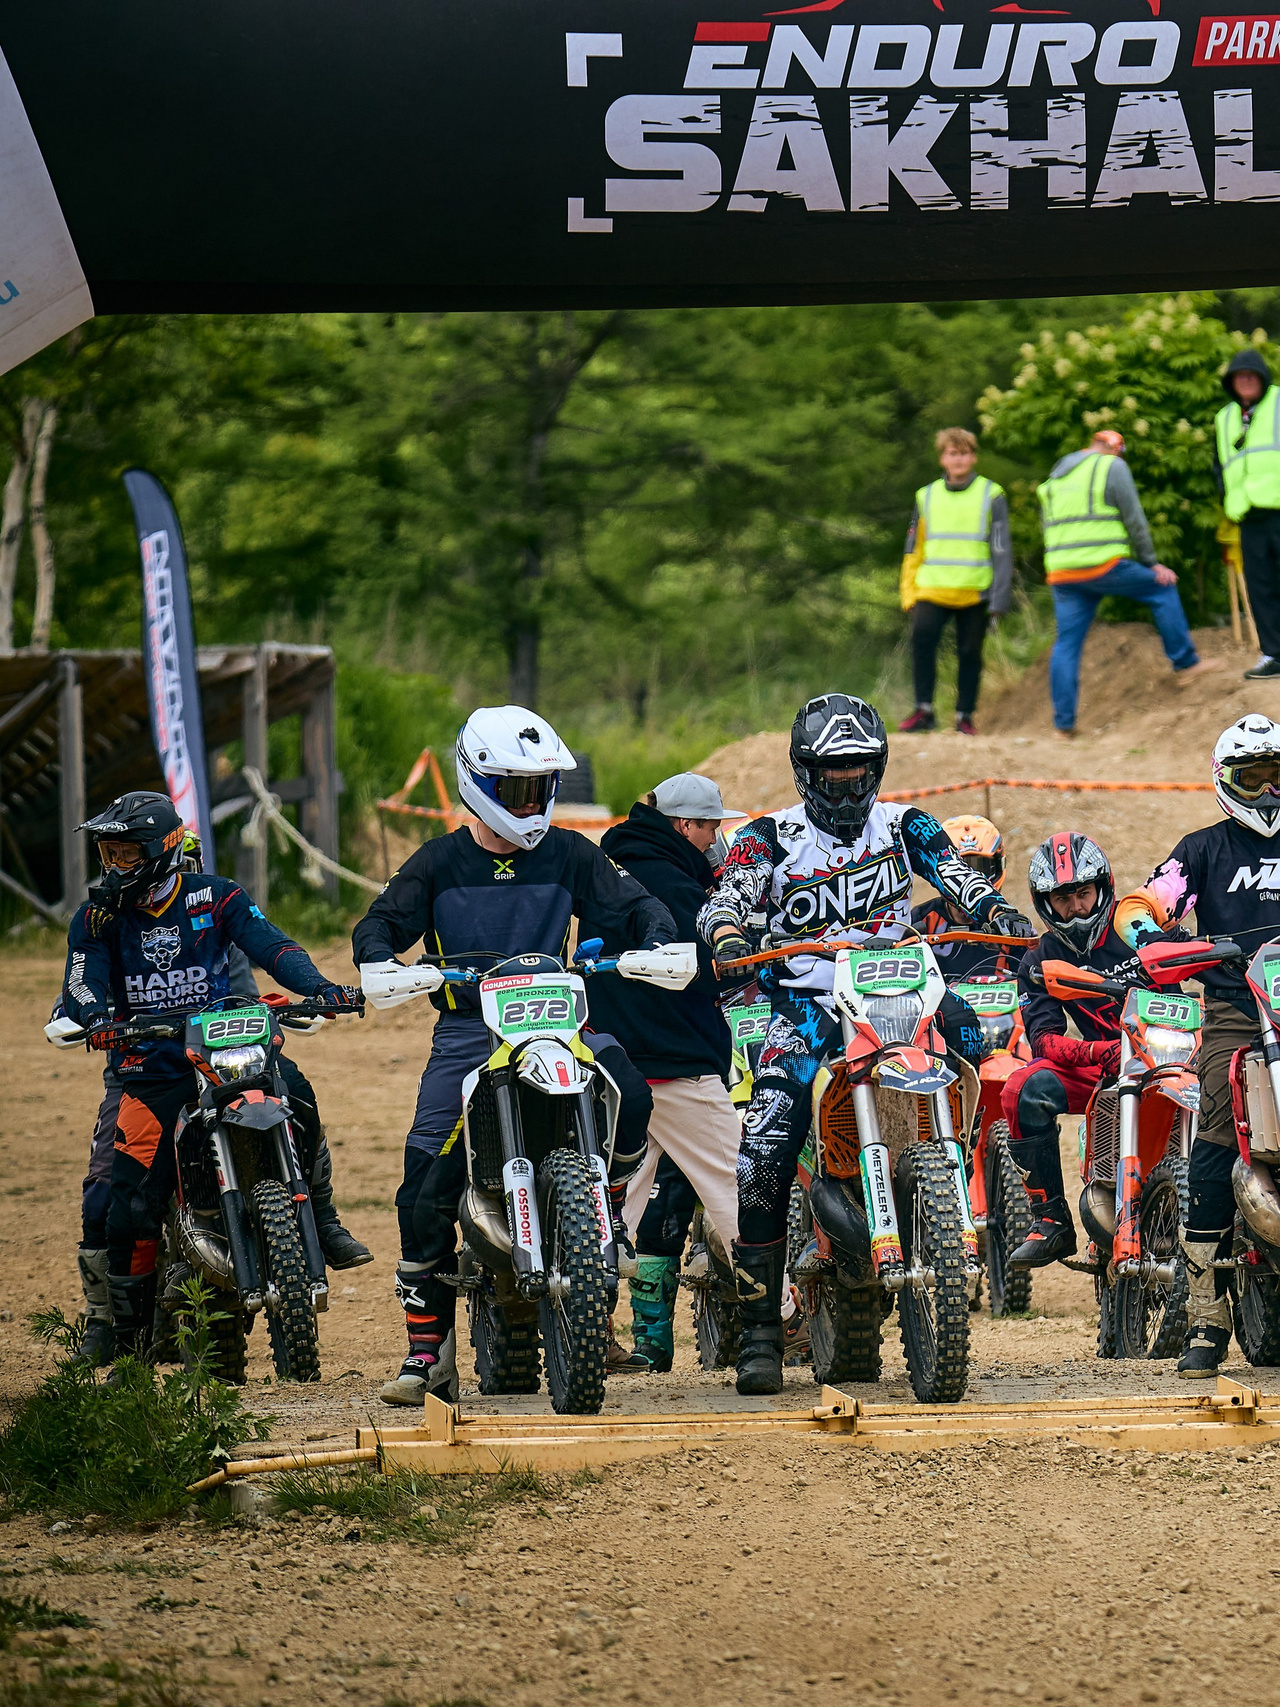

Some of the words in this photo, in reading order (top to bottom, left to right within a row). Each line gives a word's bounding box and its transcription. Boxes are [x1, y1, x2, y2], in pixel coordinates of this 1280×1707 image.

[682, 19, 1181, 90] ENDURO
[125, 966, 207, 991] HARD
[484, 978, 530, 990] КОНДРАТЬЕВ
[855, 959, 922, 985] 292
[127, 981, 209, 1003] ENDURO
[157, 994, 209, 1009] ALMATY
[516, 990, 558, 998] BRONZE
[964, 990, 1016, 1007] 299
[503, 998, 570, 1025] 272
[1147, 1000, 1191, 1021] 211
[206, 1017, 266, 1041] 295
[871, 1148, 888, 1214] METZELER
[517, 1187, 532, 1246] OSSPORT
